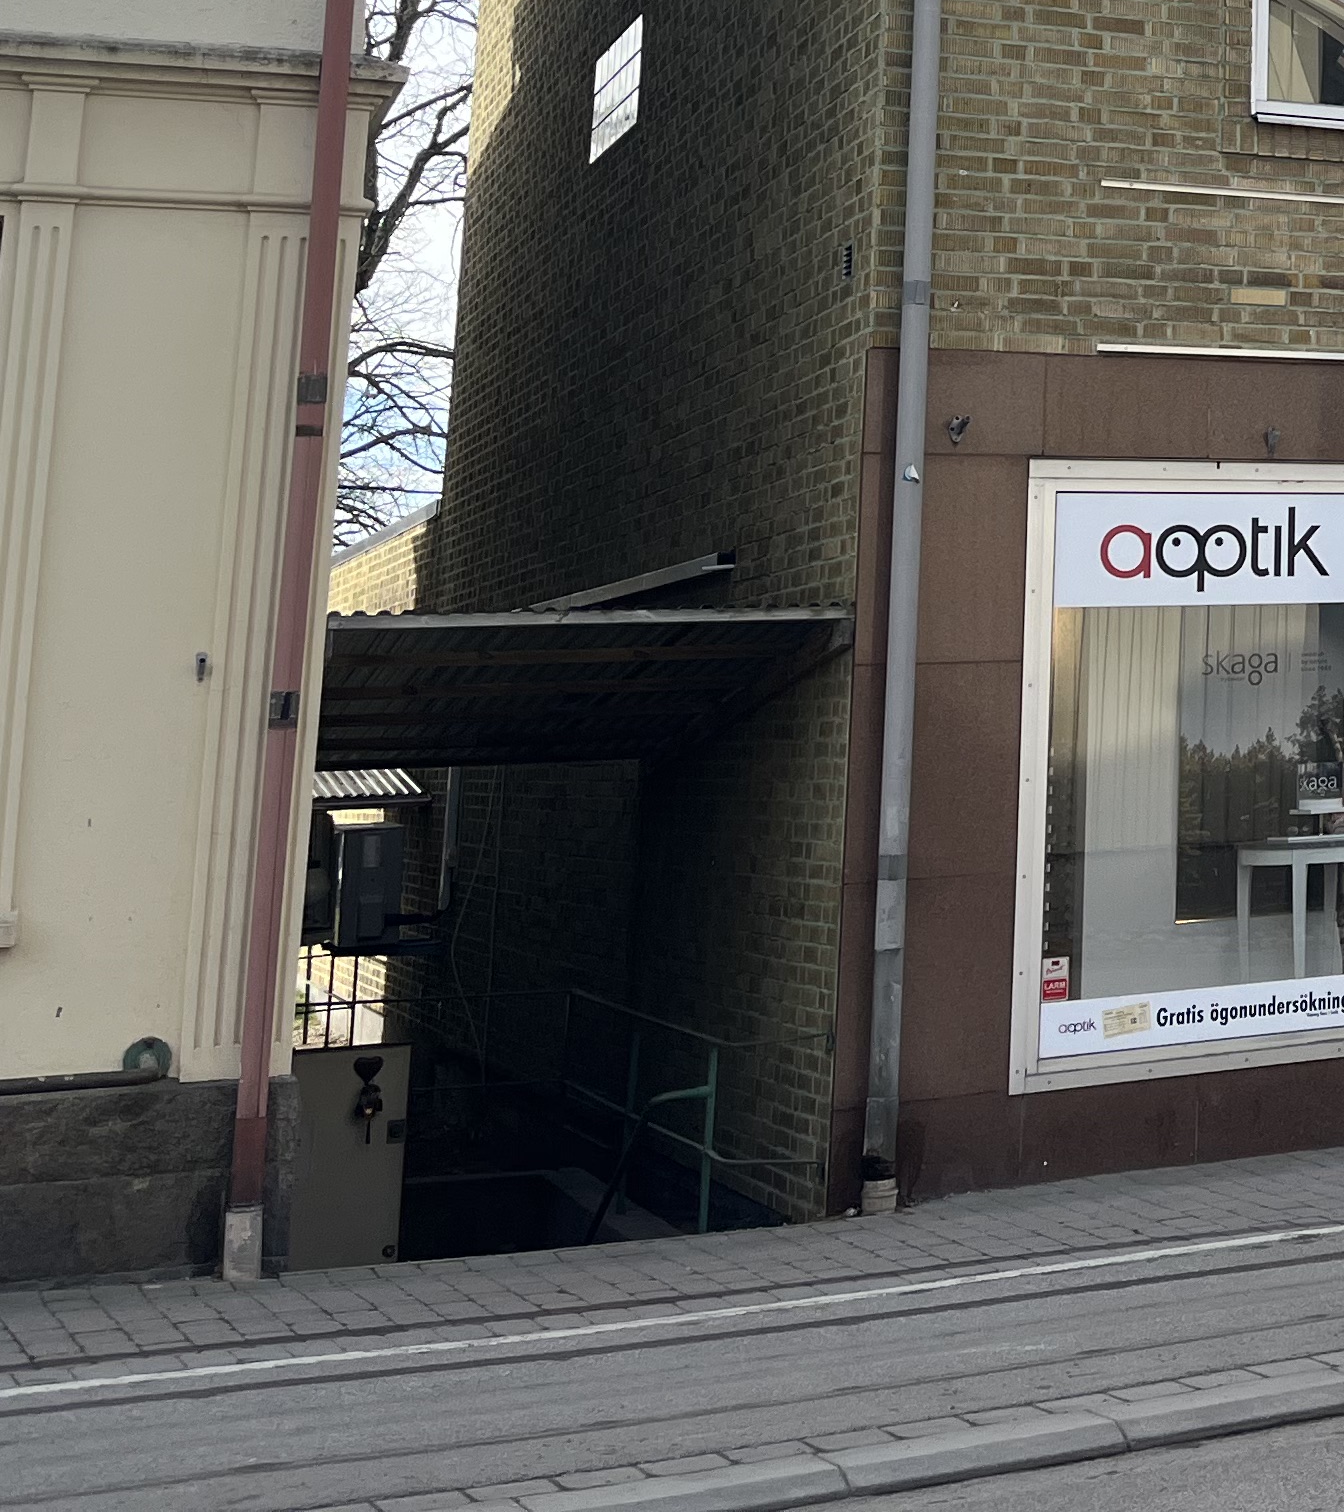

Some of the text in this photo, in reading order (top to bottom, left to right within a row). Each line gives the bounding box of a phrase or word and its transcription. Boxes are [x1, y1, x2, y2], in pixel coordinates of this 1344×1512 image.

[1100, 506, 1329, 592] aoptik
[1202, 650, 1278, 685] skaga
[1044, 981, 1066, 990] LARM
[1058, 1018, 1097, 1035] aoptik
[1156, 1004, 1204, 1027] Gratis
